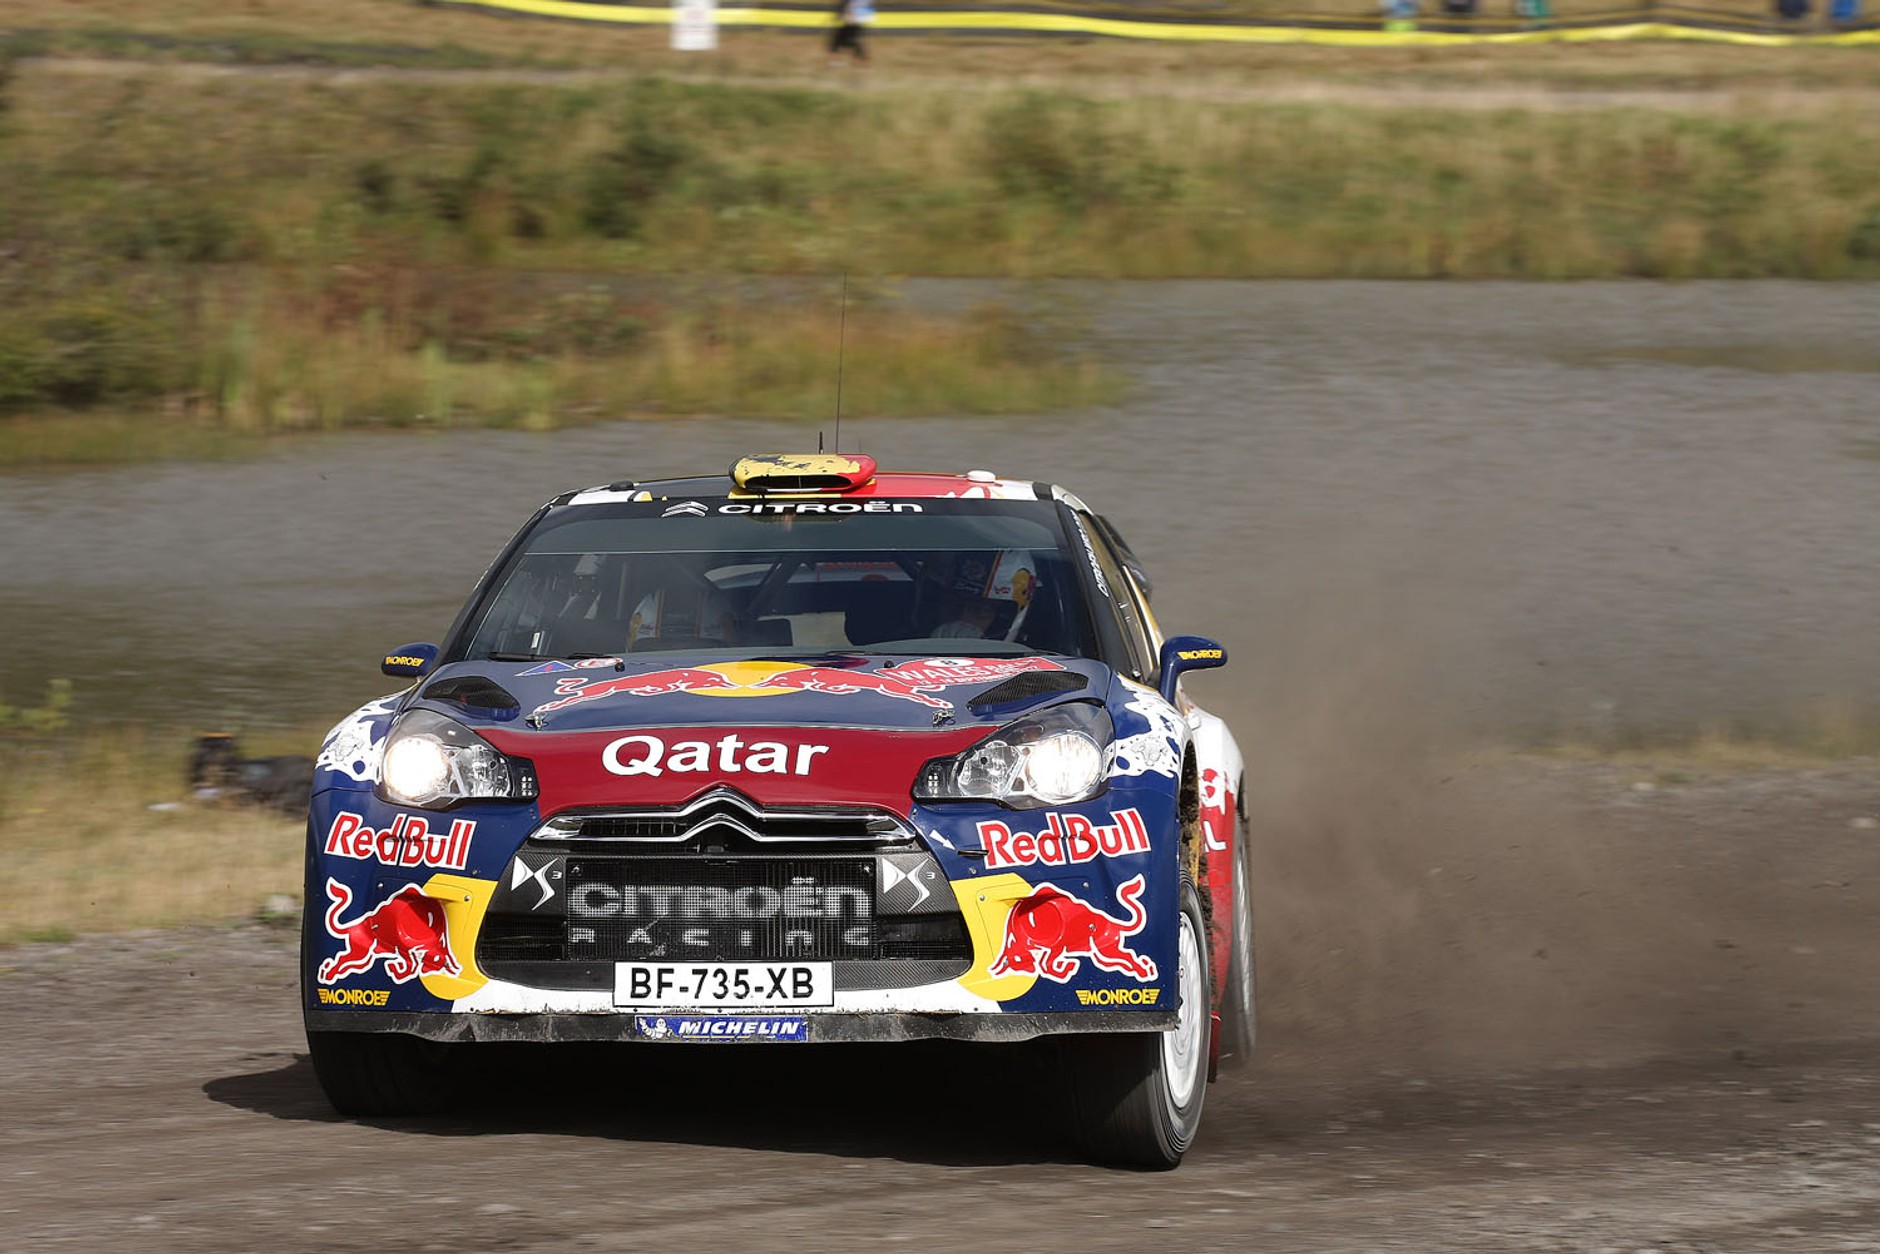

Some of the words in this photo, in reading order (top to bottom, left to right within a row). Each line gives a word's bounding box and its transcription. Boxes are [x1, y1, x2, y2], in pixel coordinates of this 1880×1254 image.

[384, 656, 422, 666] MONROE
[1179, 649, 1222, 660] MONROE
[887, 666, 990, 681] WALES
[602, 733, 830, 777] Qatar
[630, 967, 815, 1001] BF-735-XB
[321, 989, 387, 1005] MONROE
[1081, 989, 1156, 1005] MONROE
[677, 1021, 801, 1036] MICHELIN
